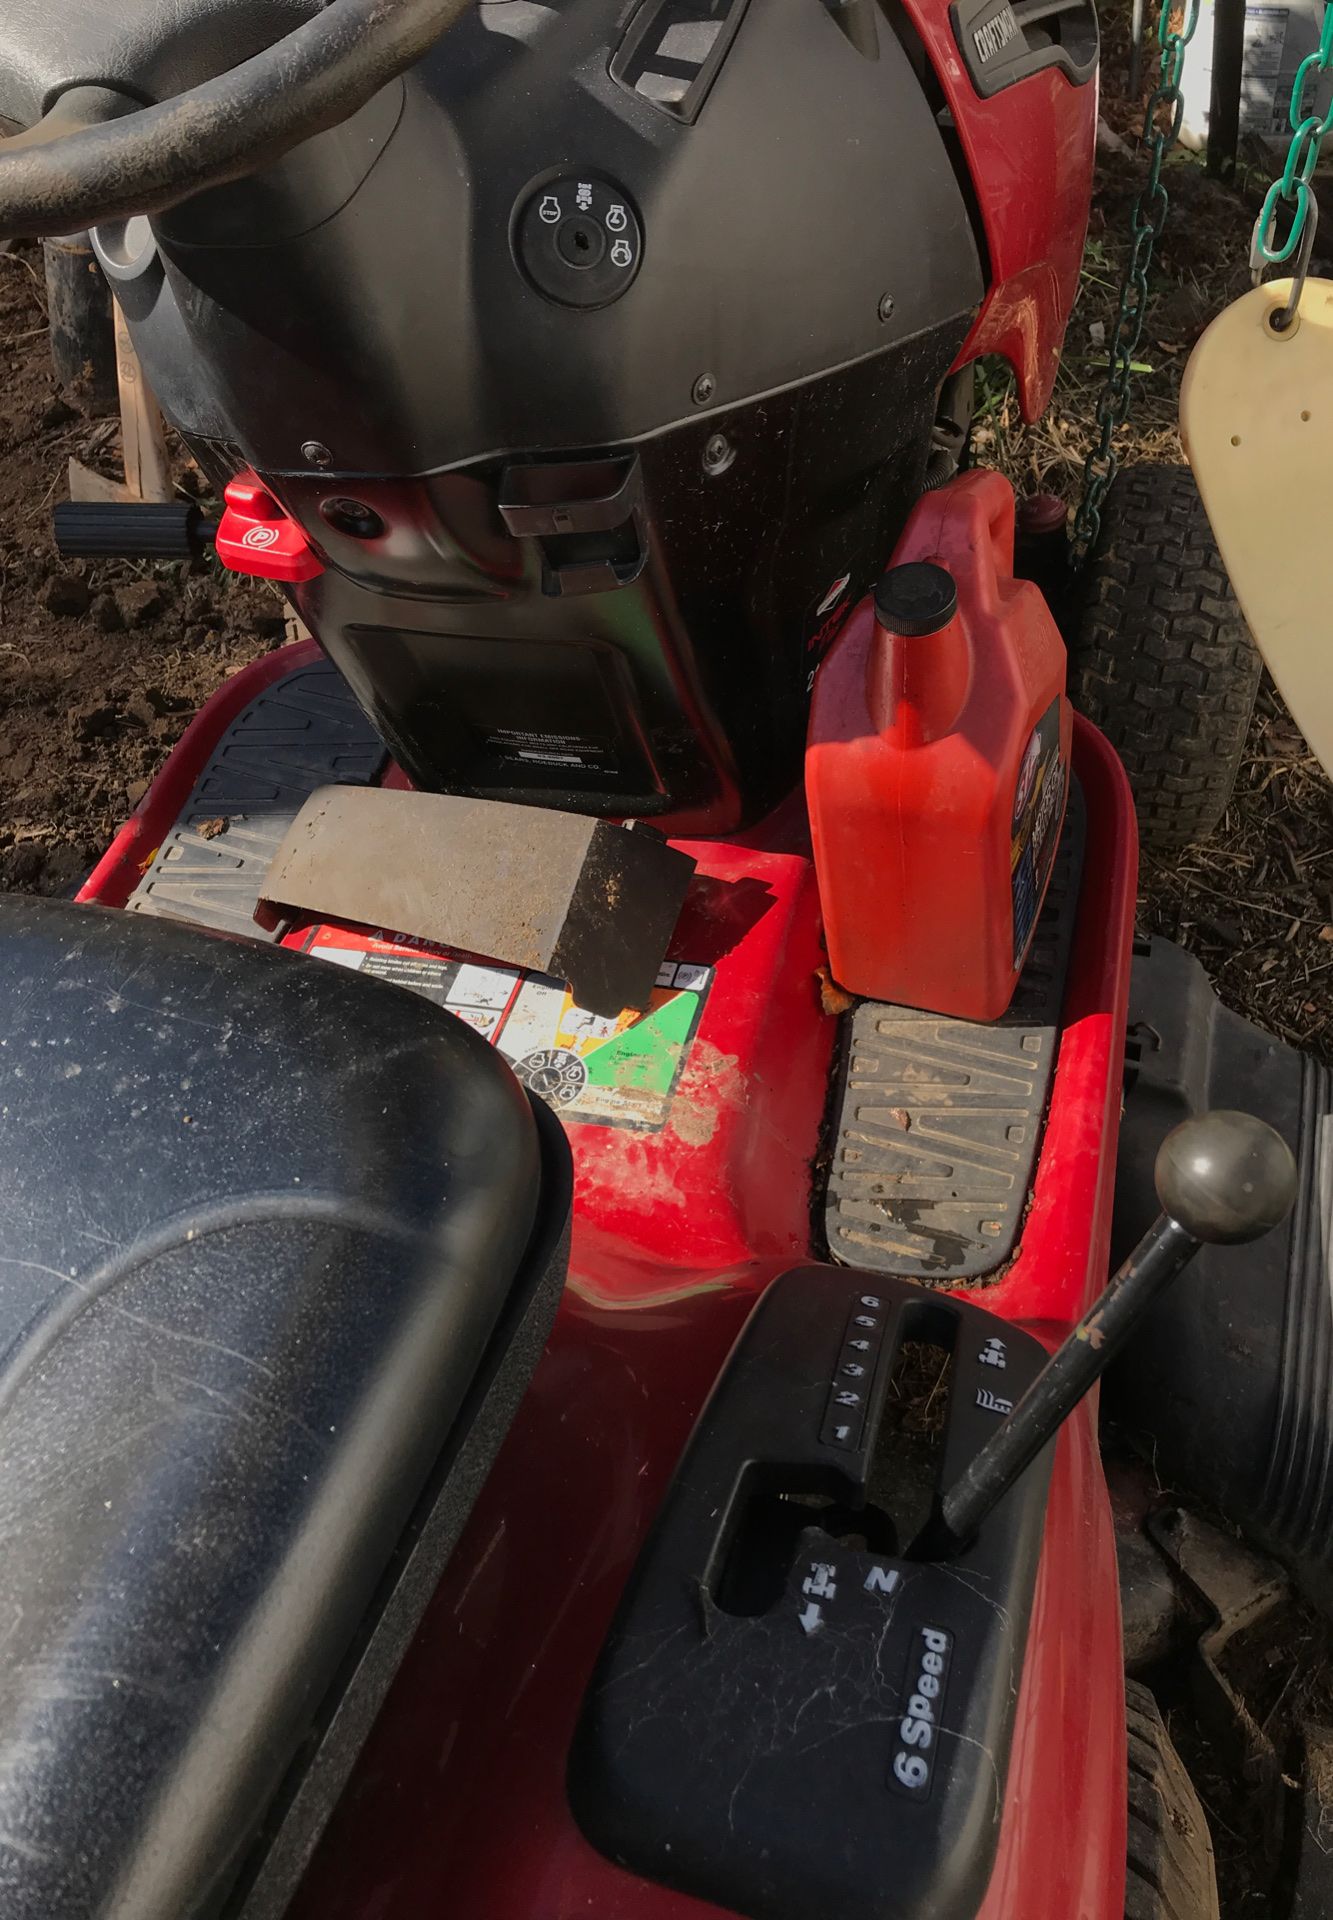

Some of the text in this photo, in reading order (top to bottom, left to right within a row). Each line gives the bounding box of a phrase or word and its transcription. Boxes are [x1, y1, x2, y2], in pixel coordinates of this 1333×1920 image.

[973, 6, 1018, 63] CRAFTSMAN
[497, 728, 538, 738] IMPORTANT
[515, 736, 567, 745] INFORMATION
[860, 1295, 880, 1308] 6
[855, 1315, 877, 1328] 5
[848, 1339, 870, 1351] 4
[841, 1363, 865, 1377] 3
[835, 1391, 860, 1407] 2
[835, 1425, 850, 1440] 1
[864, 1566, 899, 1593] N
[893, 1627, 948, 1788] 6 Speed
